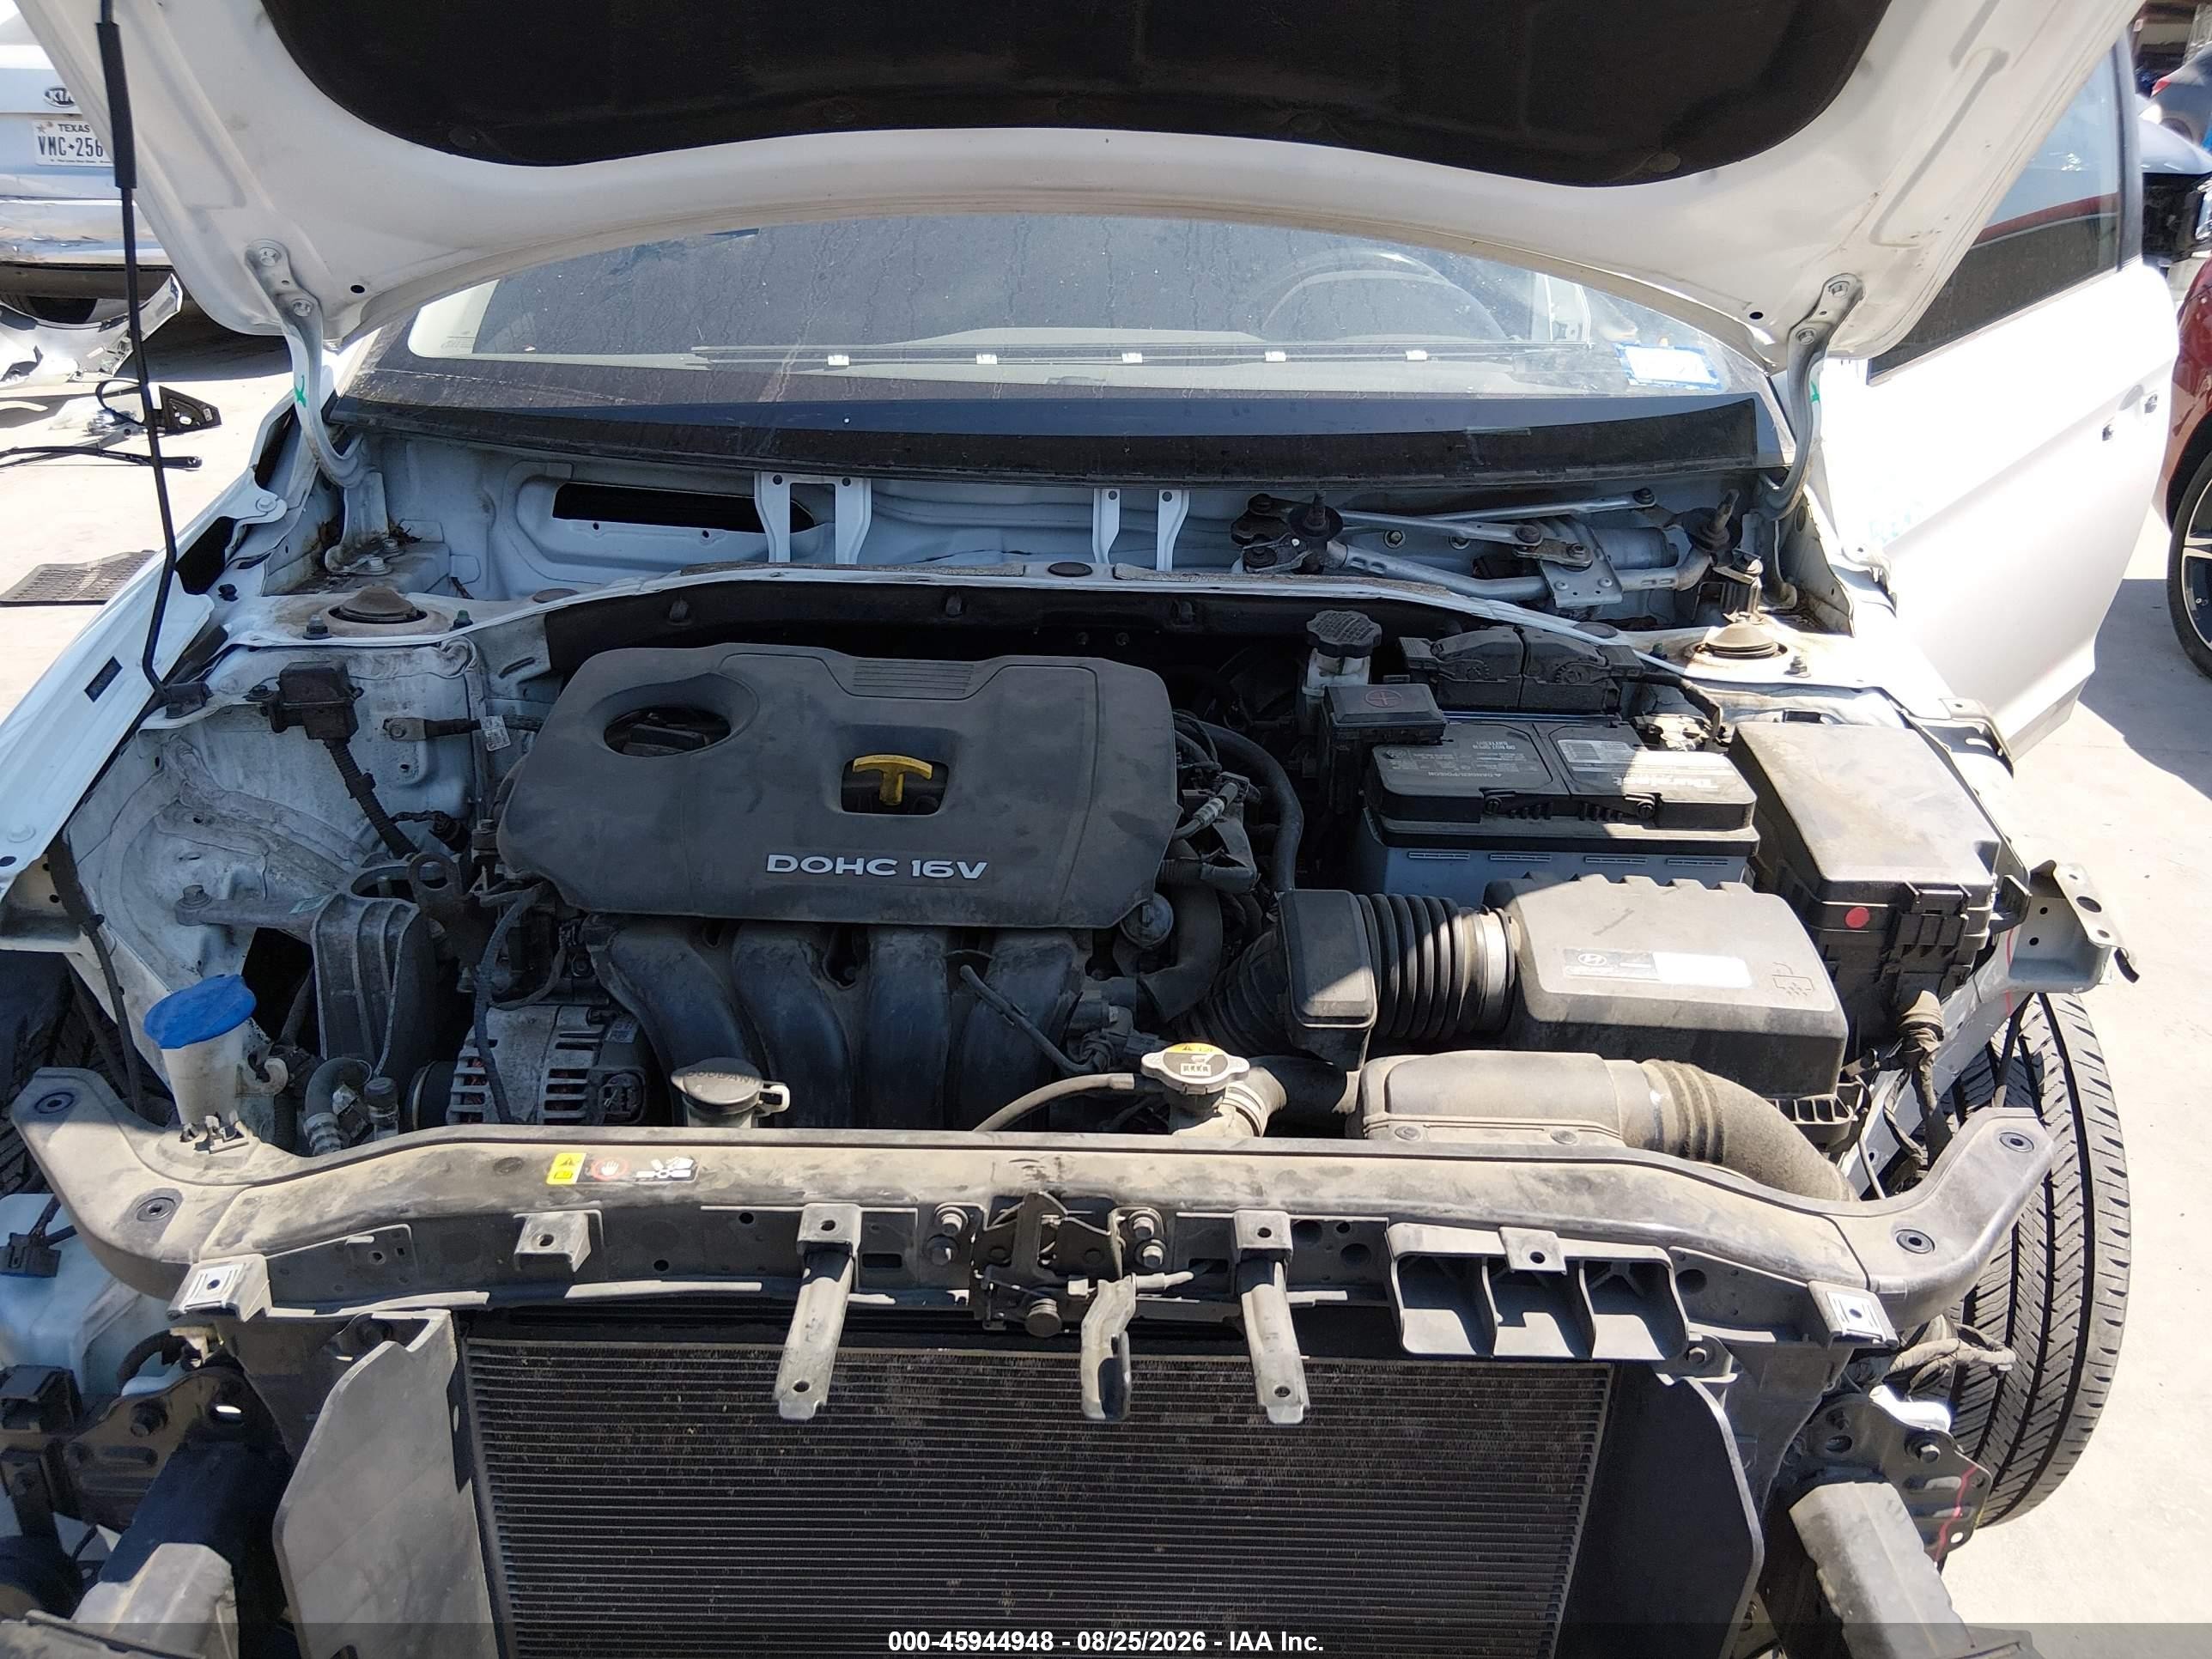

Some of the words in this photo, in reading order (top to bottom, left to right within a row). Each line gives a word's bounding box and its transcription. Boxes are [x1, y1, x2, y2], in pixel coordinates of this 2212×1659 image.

[58, 123, 90, 133] TEXAS
[765, 854, 898, 877] DOHC
[911, 859, 988, 880] 16V
